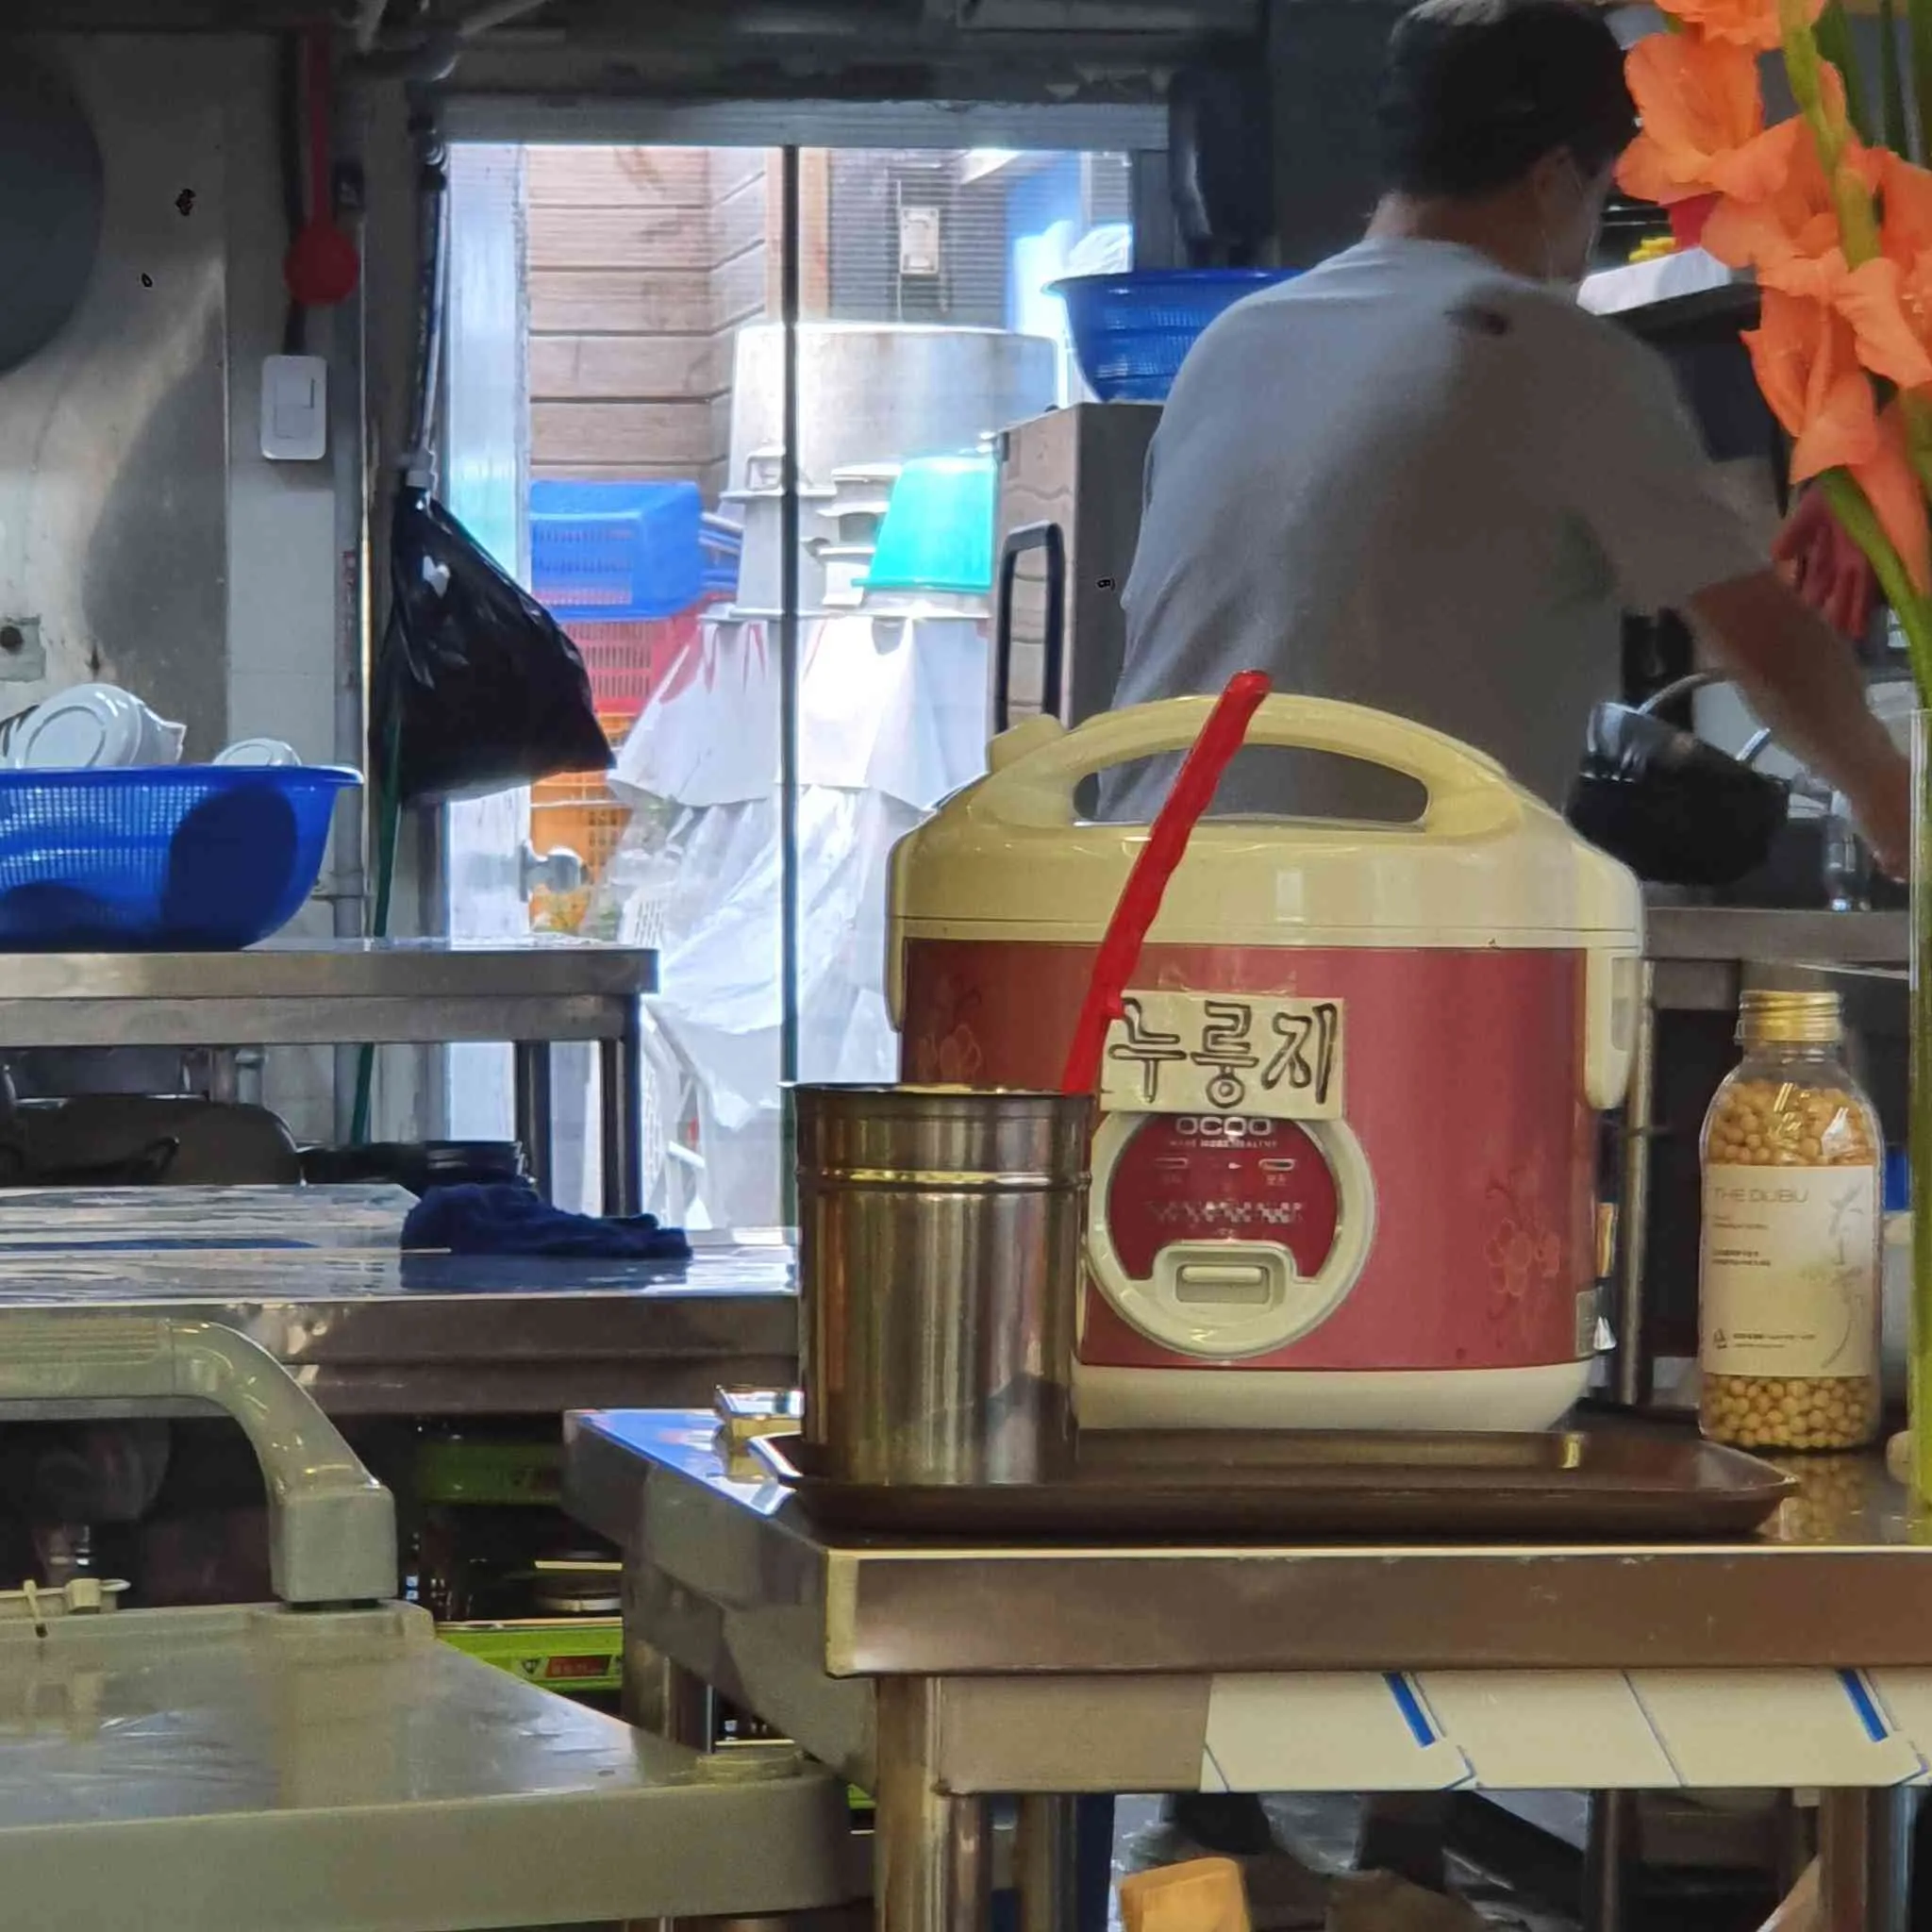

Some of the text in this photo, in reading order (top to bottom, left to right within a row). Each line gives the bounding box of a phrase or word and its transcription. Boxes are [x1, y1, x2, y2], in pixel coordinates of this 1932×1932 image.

[1108, 996, 1338, 1108] 누룽지
[1714, 1187, 1809, 1204] THE DUBU
